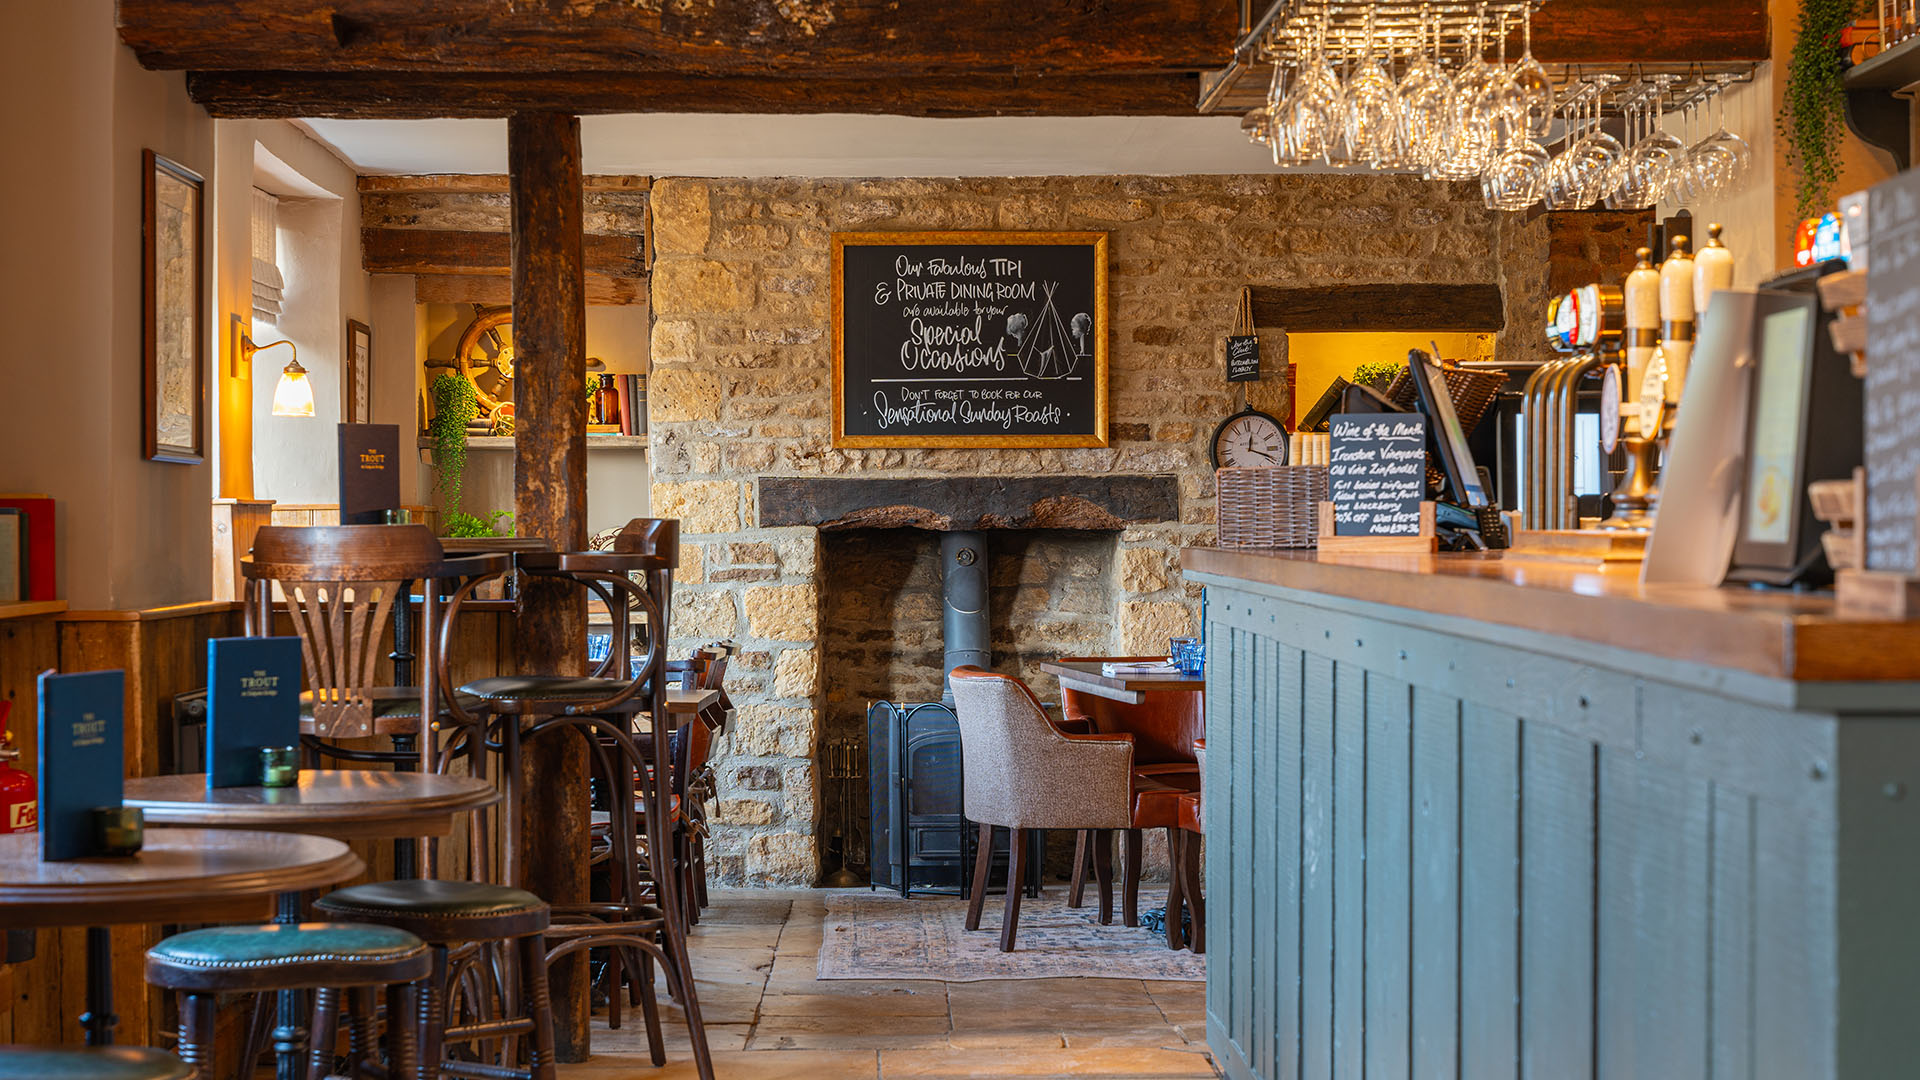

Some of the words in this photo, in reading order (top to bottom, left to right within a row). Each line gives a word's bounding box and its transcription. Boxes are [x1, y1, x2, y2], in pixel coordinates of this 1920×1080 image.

[896, 255, 923, 277] Our
[927, 256, 986, 279] Fabulous
[989, 259, 1022, 278] TIPI
[874, 282, 892, 305] &
[897, 278, 946, 301] PRIVATE
[951, 282, 994, 302] DINING
[995, 281, 1035, 301] ROOM
[903, 303, 920, 318] are
[923, 301, 969, 316] available
[973, 301, 986, 316] for
[985, 305, 1008, 320] your
[910, 315, 982, 354] Special
[901, 337, 1006, 372] Occasions
[902, 387, 930, 401] DON'T
[934, 390, 964, 400] FORGET
[969, 390, 979, 399] TO
[981, 389, 1003, 400] BOOK
[1005, 391, 1020, 399] FOR
[1023, 390, 1043, 399] OUR
[874, 390, 956, 429] Sensational
[960, 400, 1012, 429] Sunday
[1012, 404, 1061, 424] Roasts
[1333, 421, 1360, 437] Wine
[1362, 423, 1376, 439] of
[1374, 424, 1390, 436] the
[1392, 422, 1424, 436] Month
[1380, 442, 1425, 462] Vineyards
[1330, 464, 1346, 475] Old
[1348, 464, 1367, 475] Vine
[1369, 462, 1418, 477] Zinfandel
[240, 677, 279, 688] TROUT
